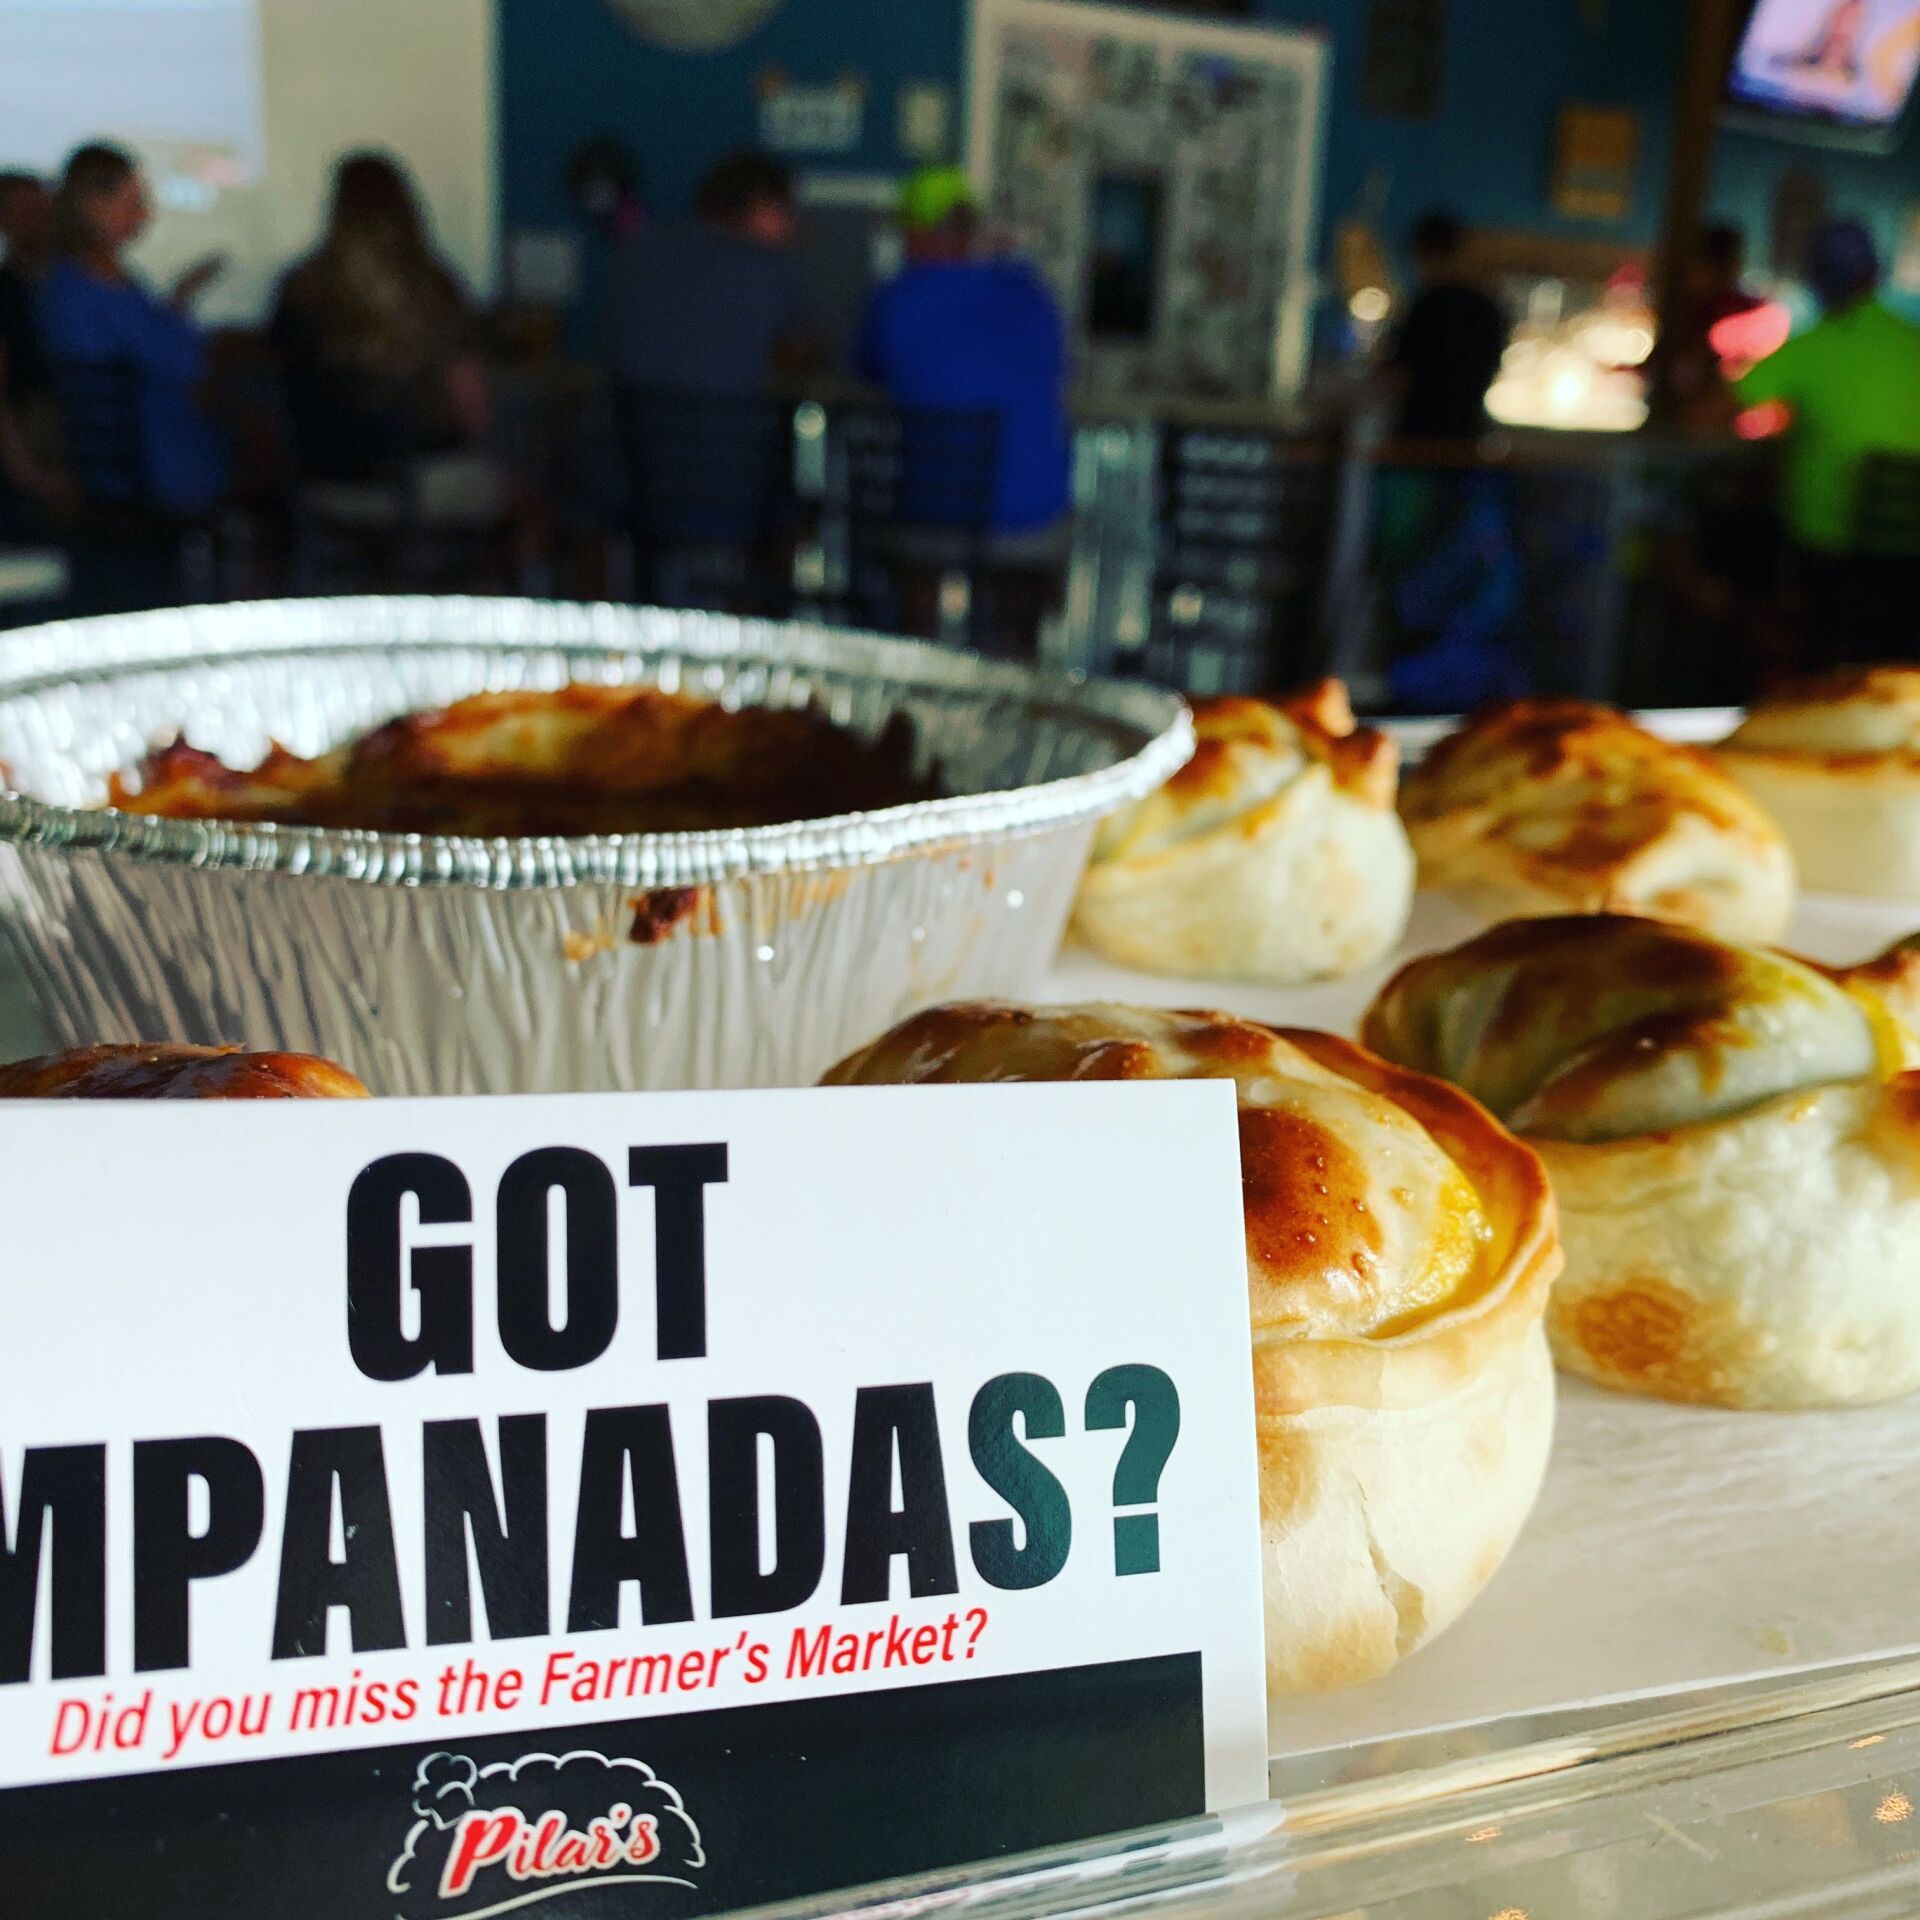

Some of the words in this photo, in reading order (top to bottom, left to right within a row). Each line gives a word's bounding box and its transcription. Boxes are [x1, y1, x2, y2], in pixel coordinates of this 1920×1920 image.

[346, 1142, 729, 1382] GOT
[50, 1690, 152, 1756] Did
[162, 1693, 272, 1760] you
[289, 1669, 419, 1733] miss
[438, 1658, 522, 1716] the
[540, 1630, 769, 1706] Farmer's
[784, 1608, 988, 1680] Market?
[438, 1804, 661, 1898] Pilar's
